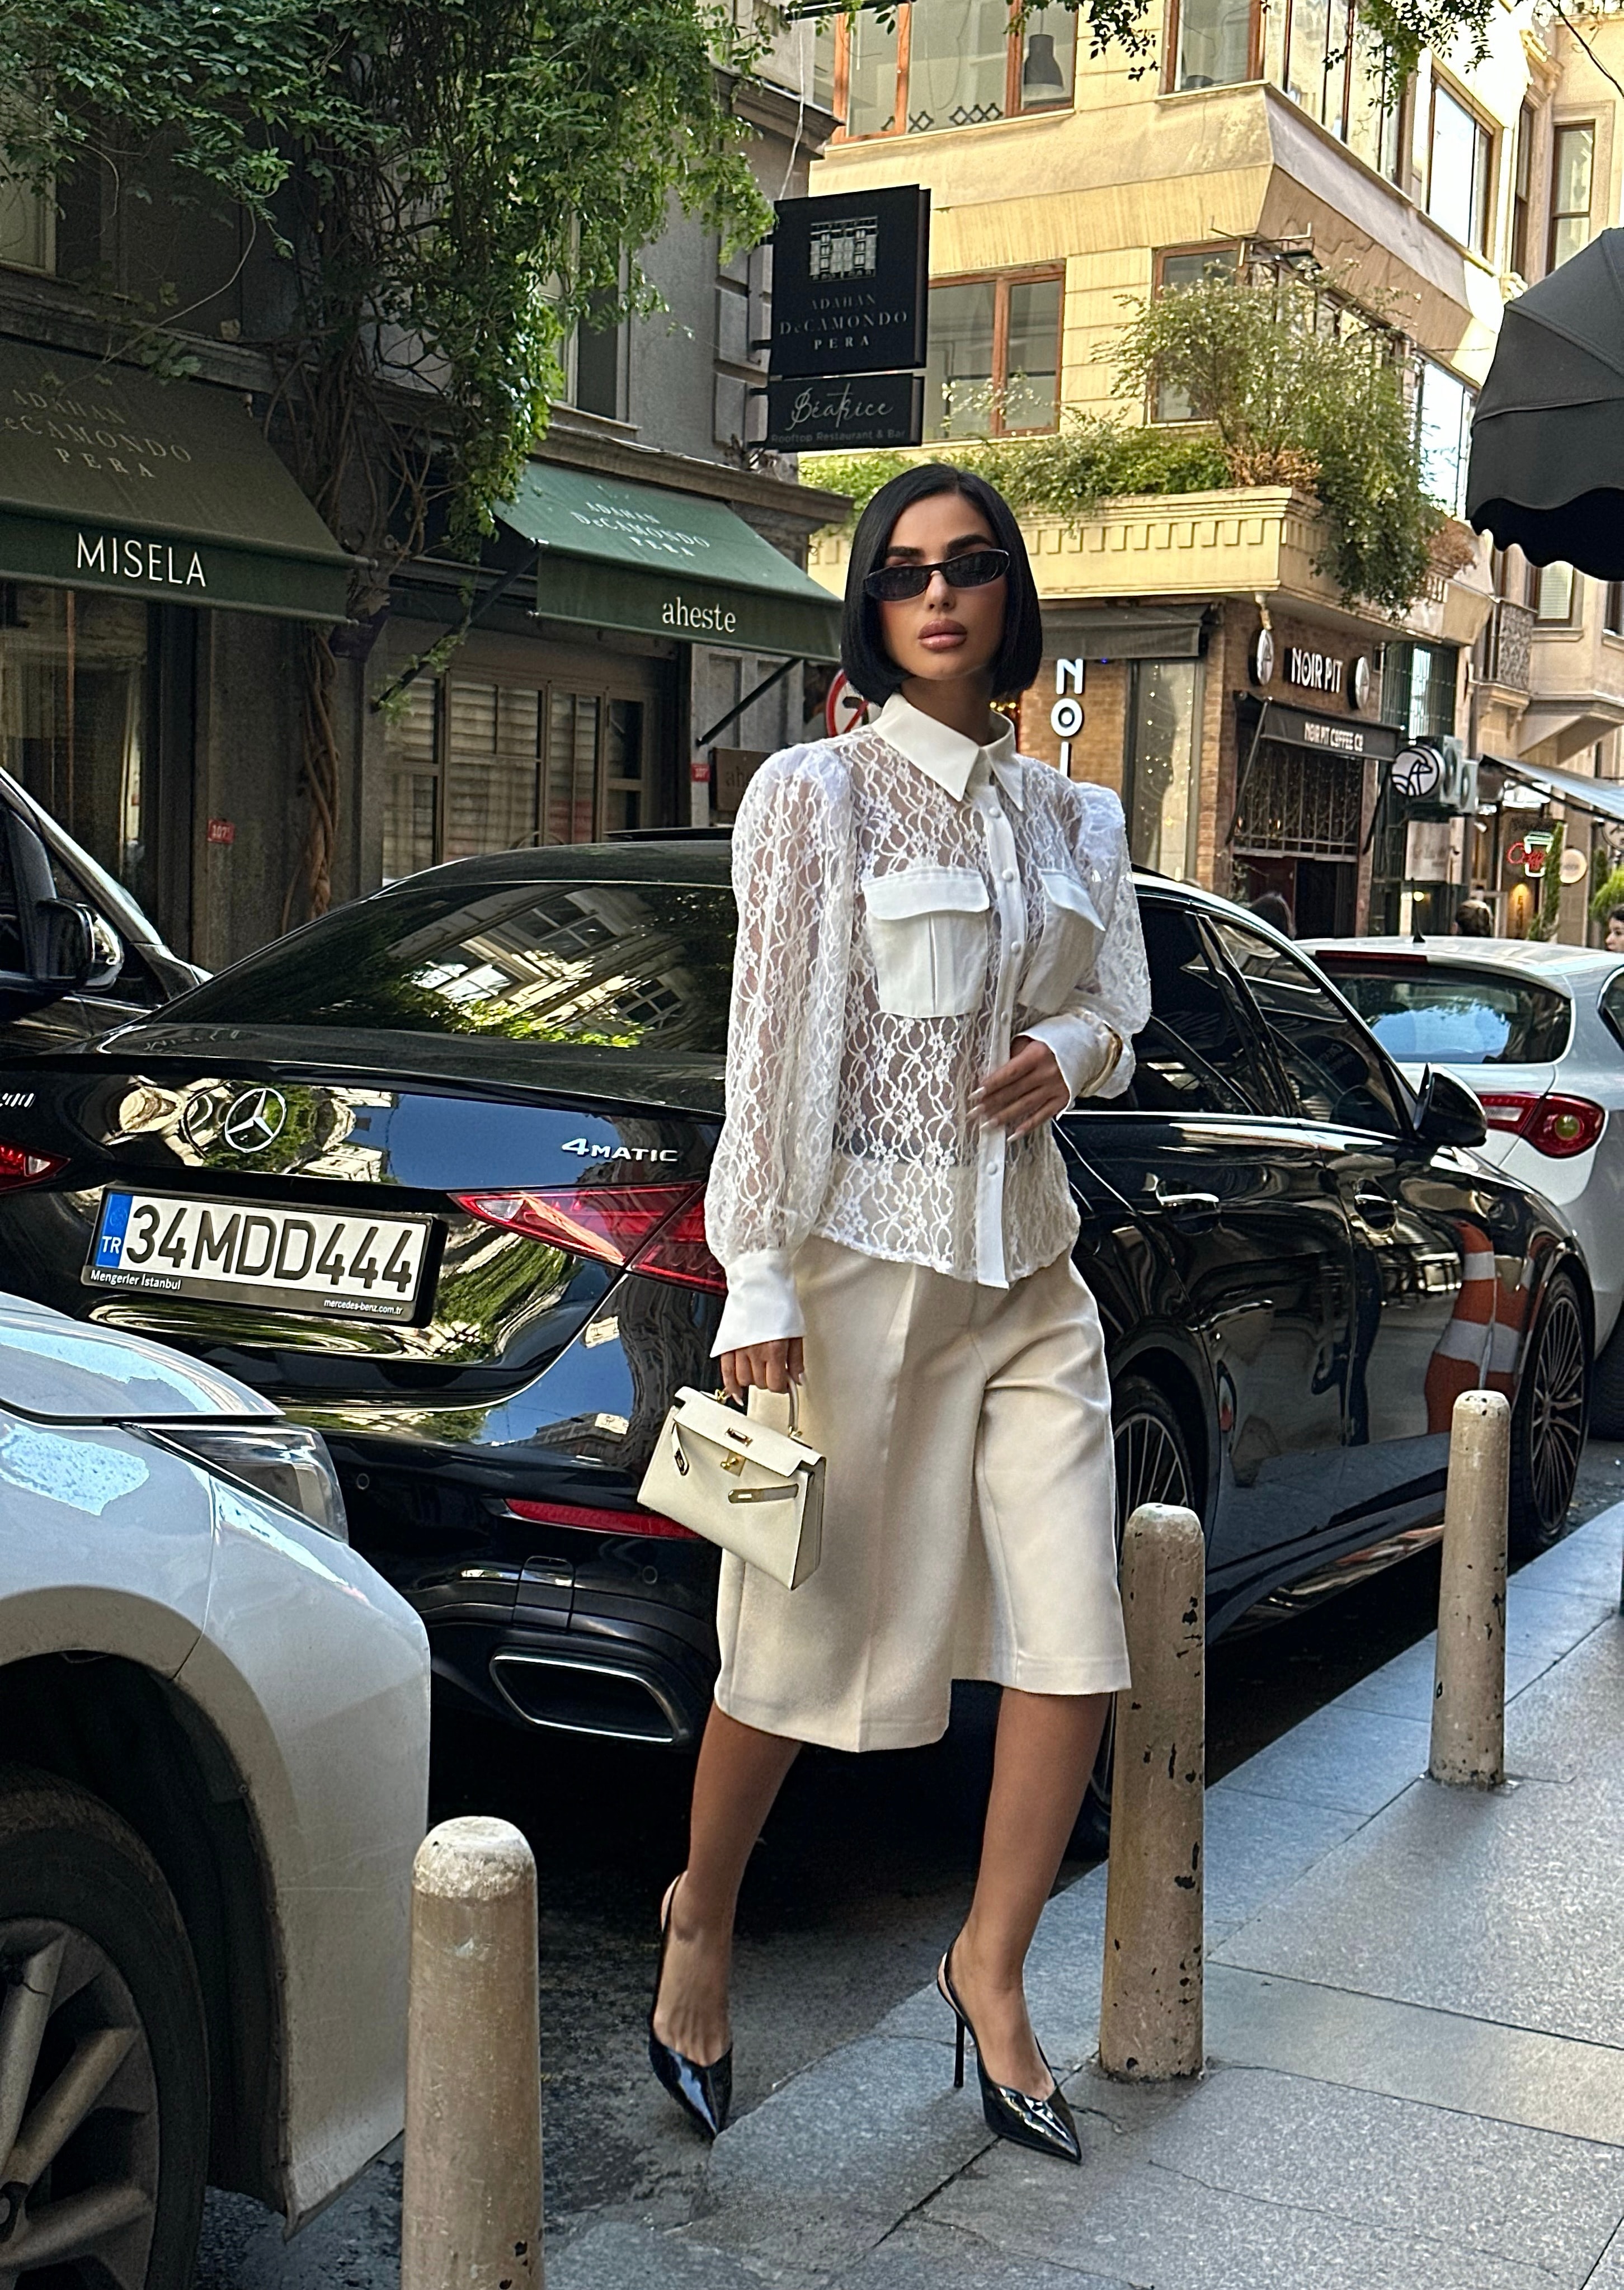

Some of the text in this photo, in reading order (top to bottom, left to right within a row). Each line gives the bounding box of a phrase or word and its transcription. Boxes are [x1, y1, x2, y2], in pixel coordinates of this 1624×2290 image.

[814, 336, 869, 351] PERA
[2, 416, 192, 463] eCAMONDO
[771, 428, 906, 444] Rooftop Restaurant & Bar
[54, 447, 157, 478] PERA
[77, 533, 206, 587] MISELA
[662, 596, 736, 633] aheste
[1291, 647, 1344, 693] NOIR PIT
[1051, 658, 1084, 779] NOI
[562, 1138, 678, 1162] 4MATIC
[102, 1236, 122, 1255] TR
[126, 1204, 412, 1293] 34MDD444
[90, 1269, 139, 1285] Mengerler
[324, 1298, 403, 1316] mercedes-benz.com.tr
